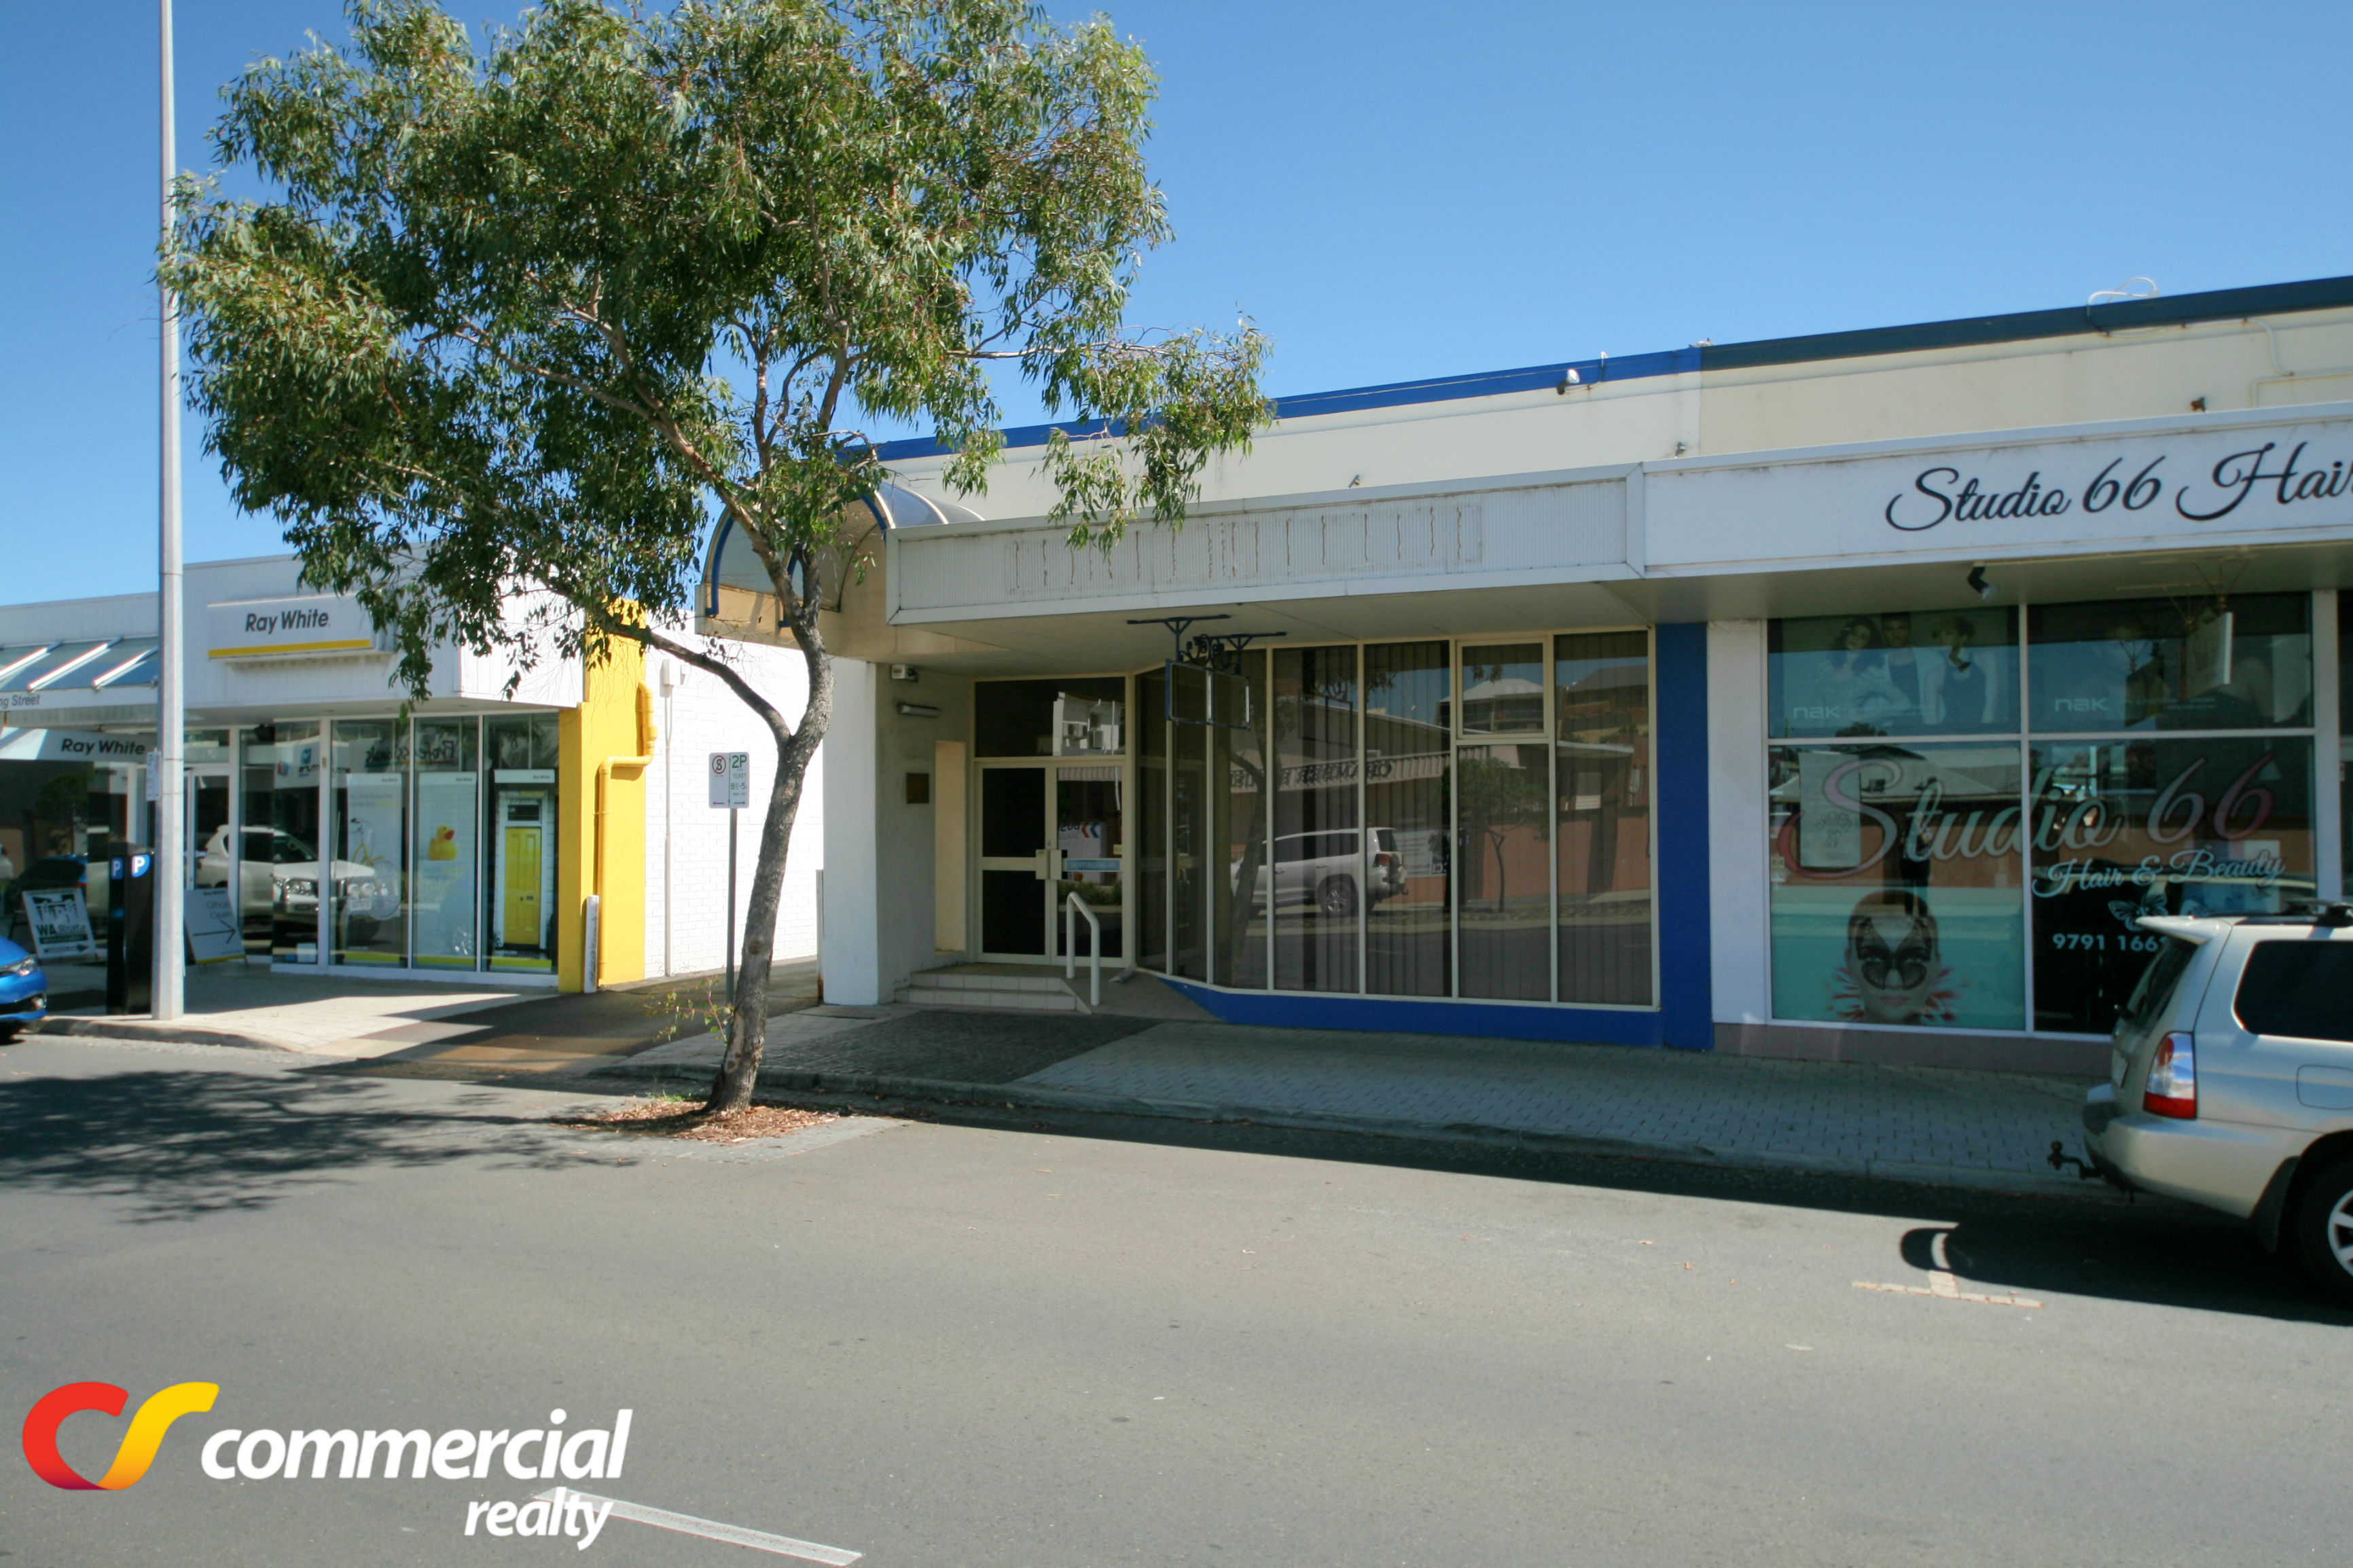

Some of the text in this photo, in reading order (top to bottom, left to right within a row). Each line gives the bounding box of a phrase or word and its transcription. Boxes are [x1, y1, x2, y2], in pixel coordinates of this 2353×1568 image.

[1886, 441, 2353, 532] Studio 66 Hai
[245, 608, 329, 635] Ray White
[12, 694, 41, 707] Street
[2054, 697, 2110, 712] nak
[61, 738, 146, 756] Ray White
[732, 754, 747, 769] 2P
[1776, 751, 2275, 879] Studio 66
[2032, 849, 2287, 898] Hair & Beauty
[36, 924, 58, 936] WA
[2051, 933, 2105, 951] 9791
